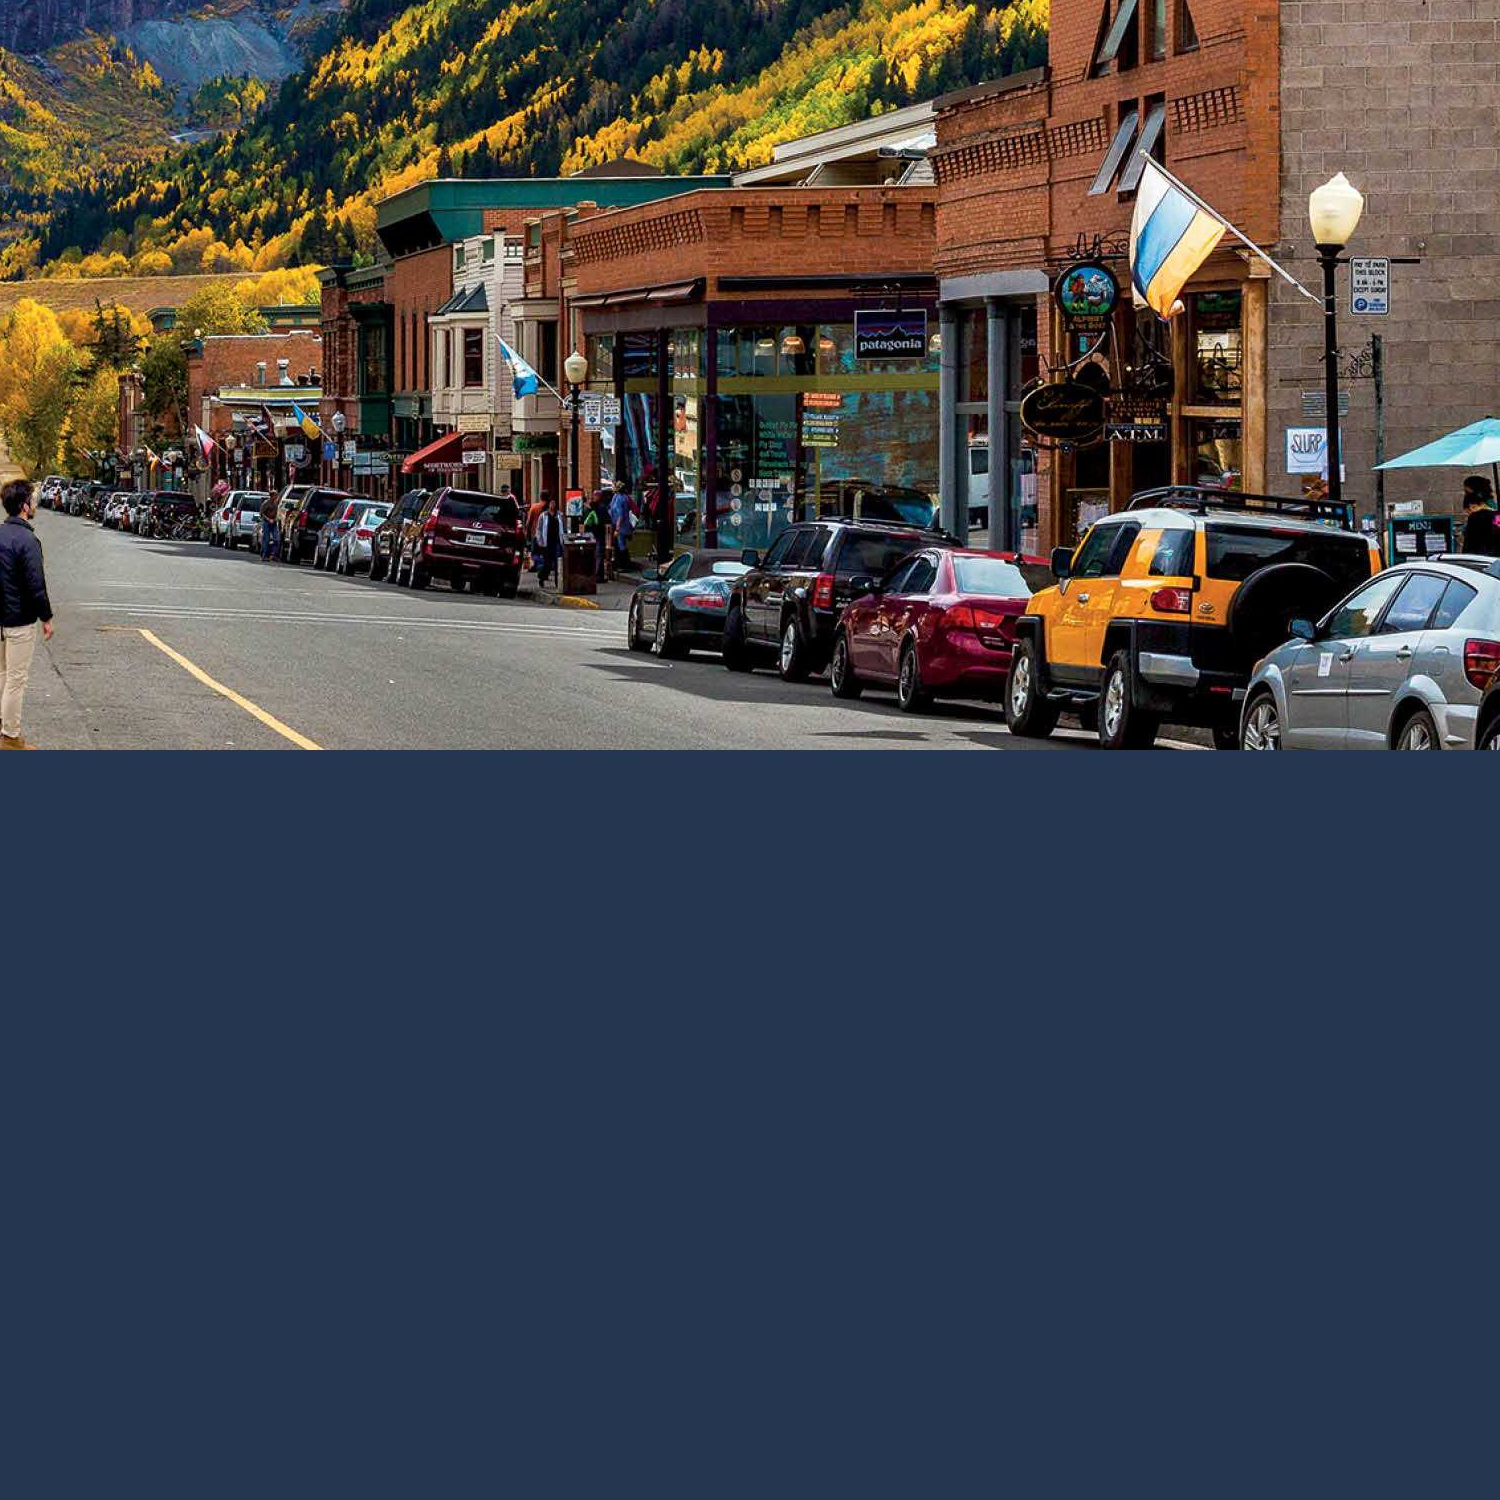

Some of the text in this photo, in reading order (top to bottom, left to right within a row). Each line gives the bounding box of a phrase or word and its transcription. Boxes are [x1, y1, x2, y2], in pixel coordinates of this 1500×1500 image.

[860, 339, 922, 352] patagonia
[1109, 430, 1163, 440] A.T.M.
[1291, 433, 1322, 453] SLURP
